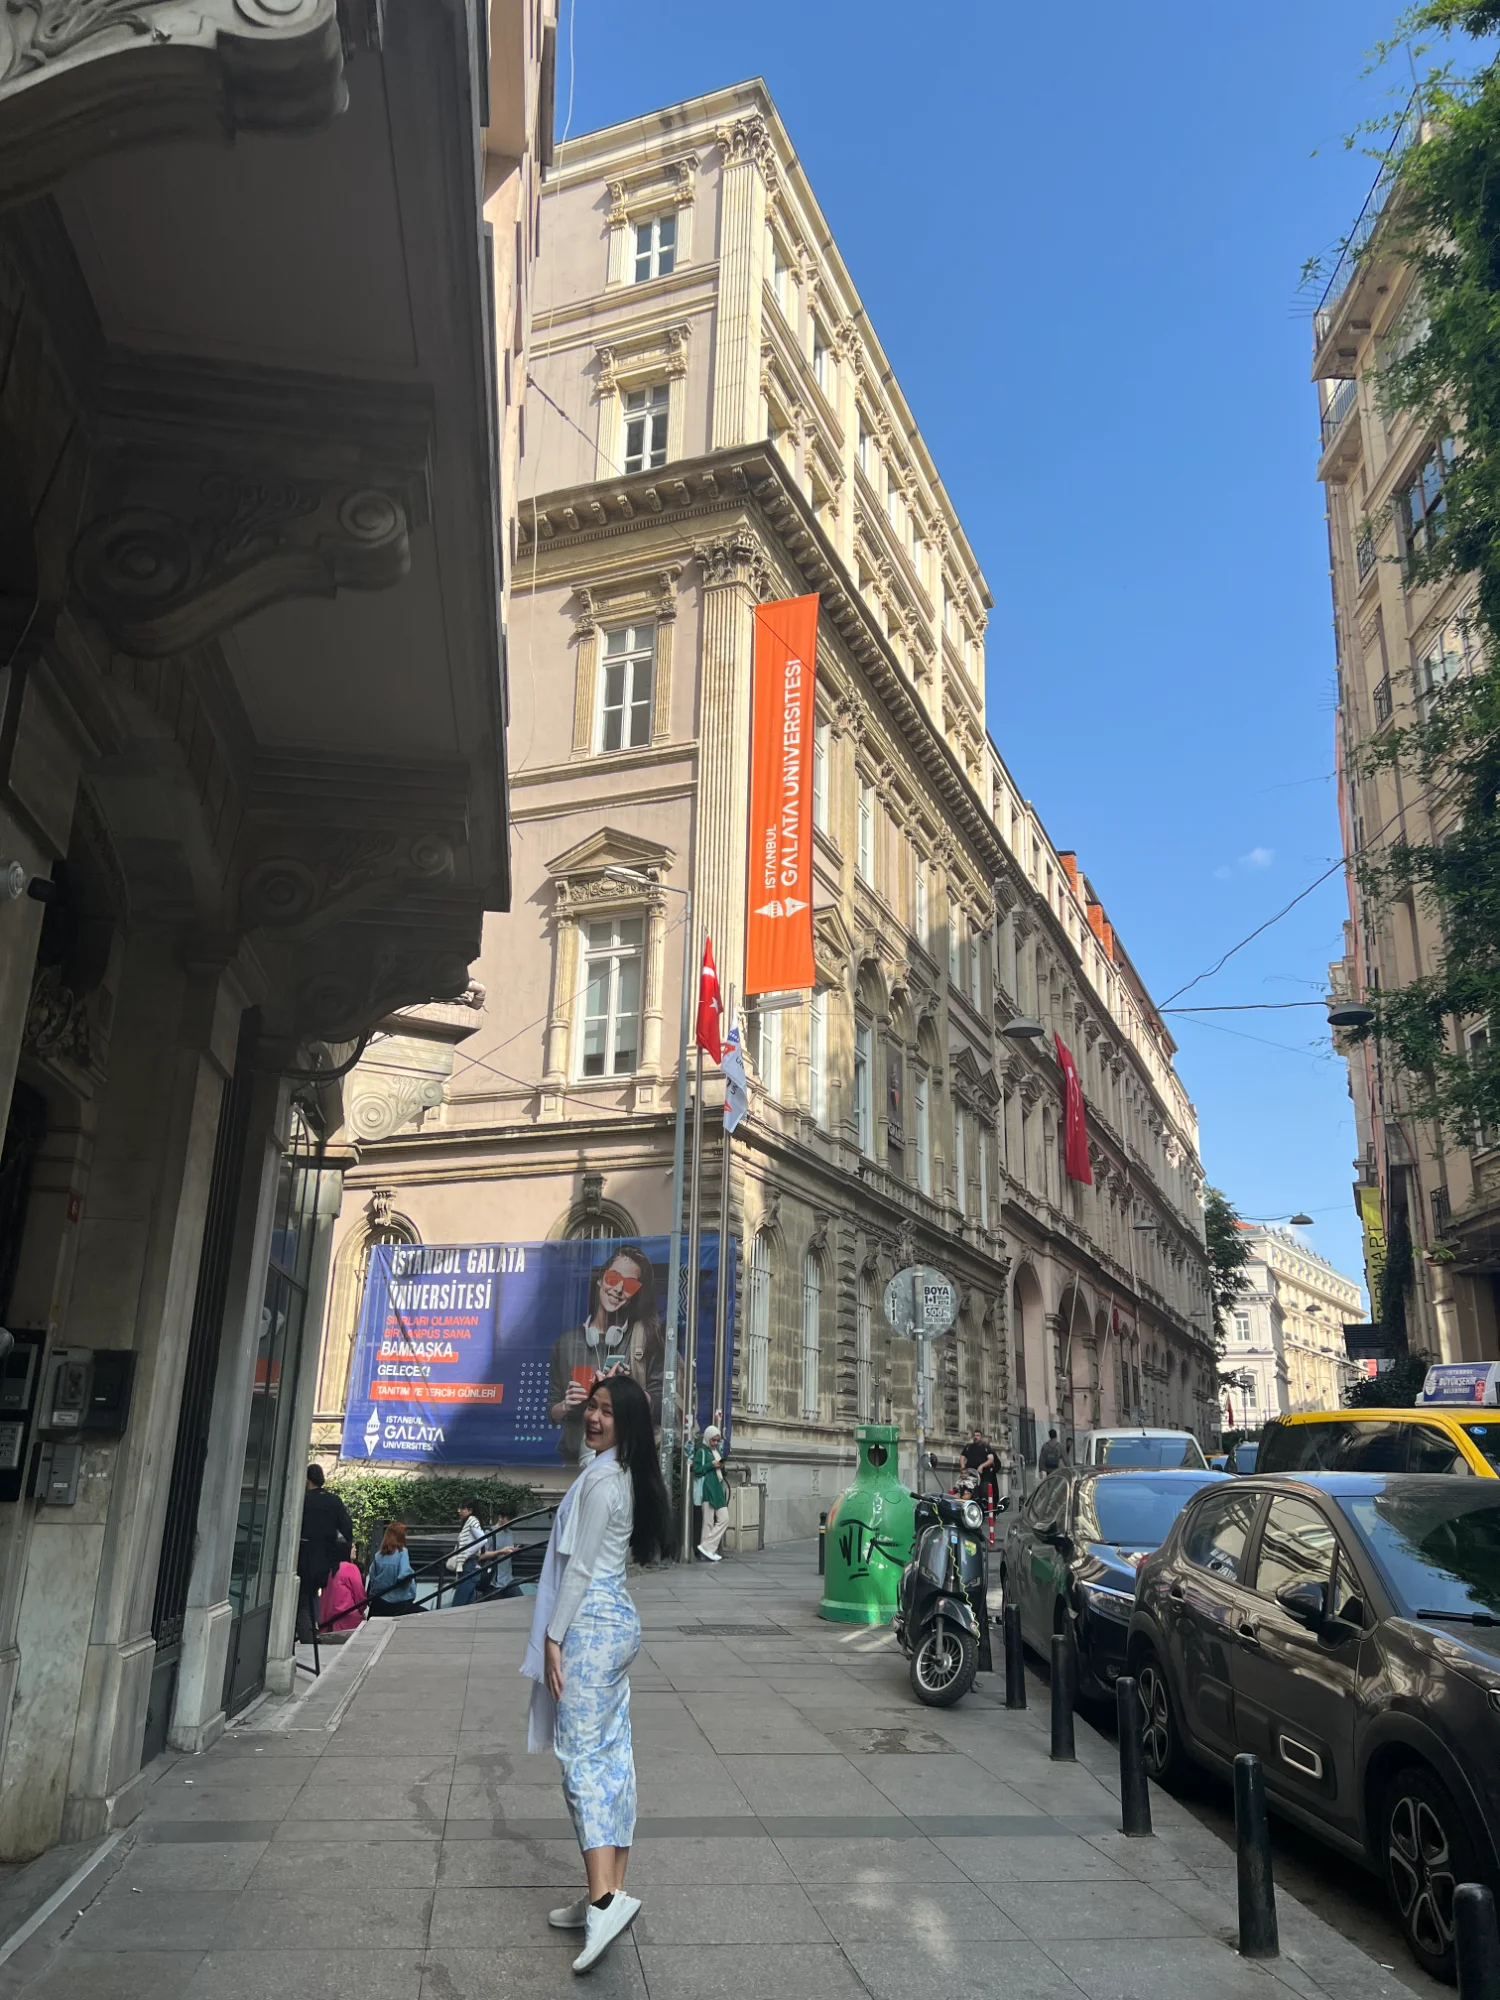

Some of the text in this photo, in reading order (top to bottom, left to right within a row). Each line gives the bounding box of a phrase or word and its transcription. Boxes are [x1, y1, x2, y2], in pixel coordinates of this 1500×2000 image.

[781, 800, 798, 886] GALATA
[765, 824, 776, 889] ISTANBUL
[391, 1246, 525, 1275] İSTANBUL GALATA
[924, 1286, 949, 1295] BOYA
[431, 1316, 479, 1326] OLMAYAN
[443, 1329, 471, 1339] SANA
[381, 1341, 453, 1361] BAMBAŞKA
[377, 1364, 431, 1377] GELECEK!
[377, 1386, 410, 1395] TANITIM
[458, 1387, 496, 1398] GÜNLERİ
[384, 1424, 445, 1442] GALATA
